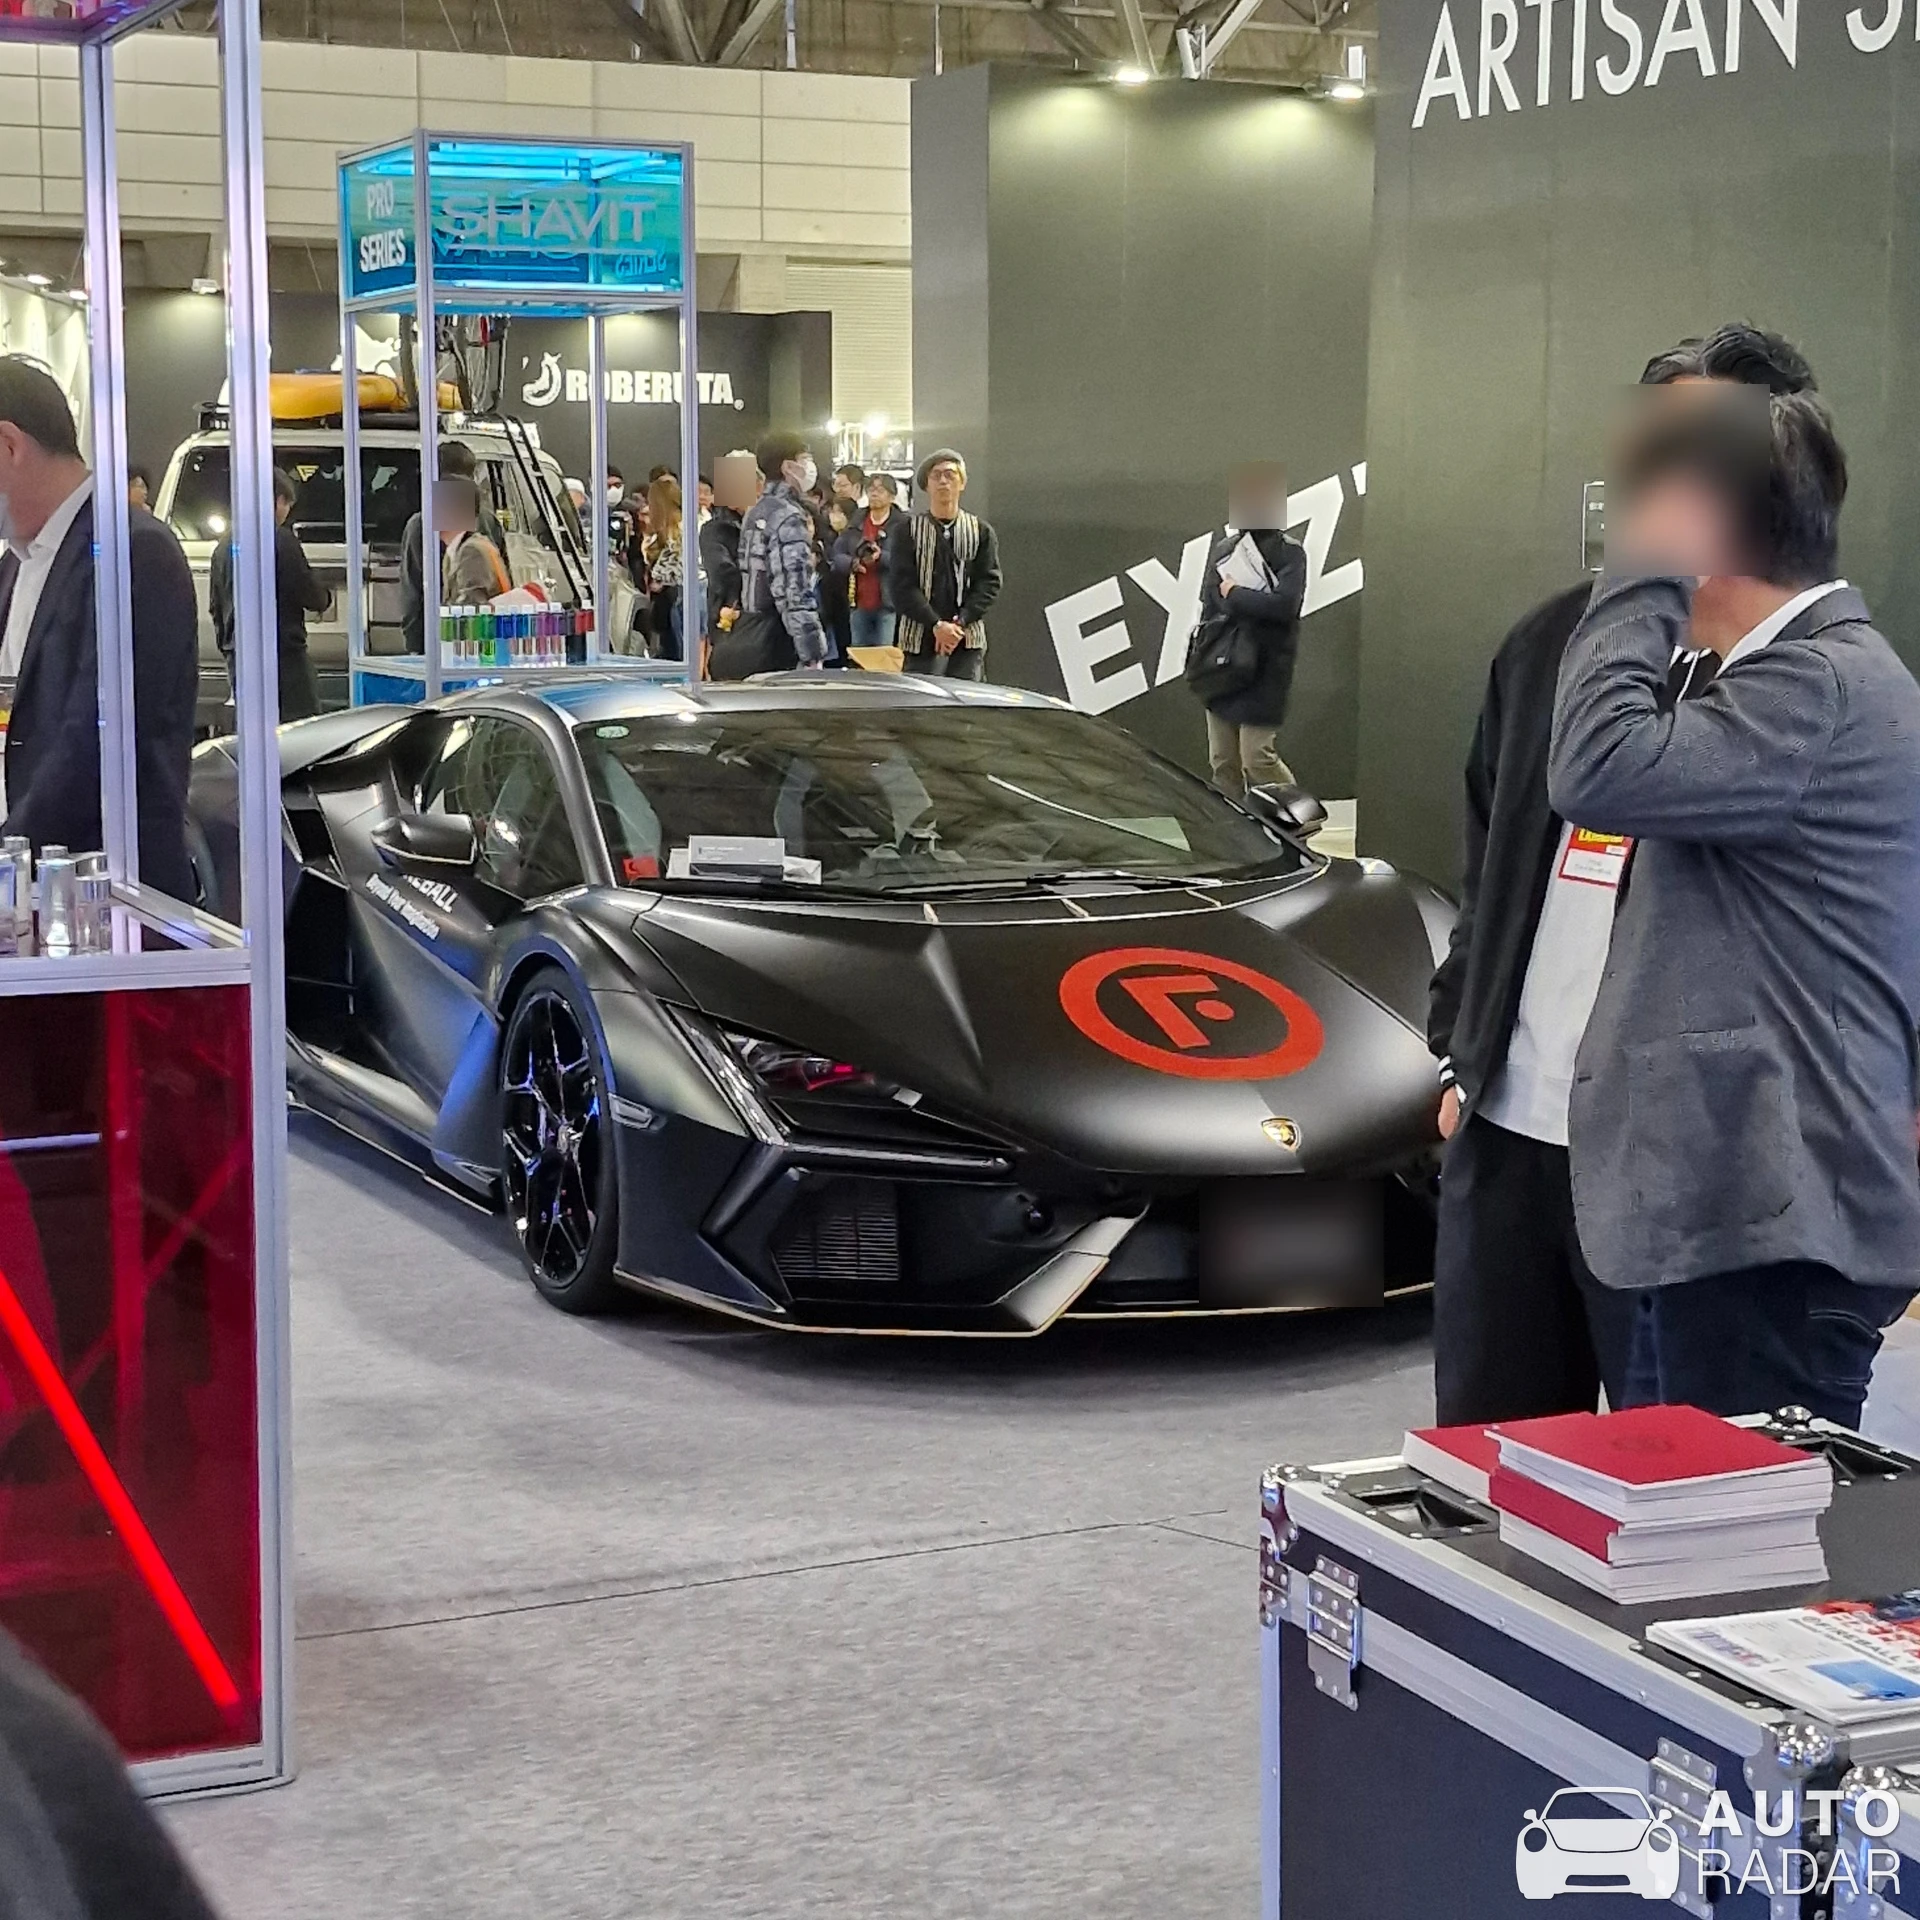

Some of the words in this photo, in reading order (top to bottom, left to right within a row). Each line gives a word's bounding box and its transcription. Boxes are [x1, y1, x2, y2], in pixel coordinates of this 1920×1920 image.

[1411, 0, 1798, 128] ARTISAN
[366, 180, 394, 220] PRO
[441, 196, 657, 244] SHAVIT
[360, 228, 407, 273] SERIES
